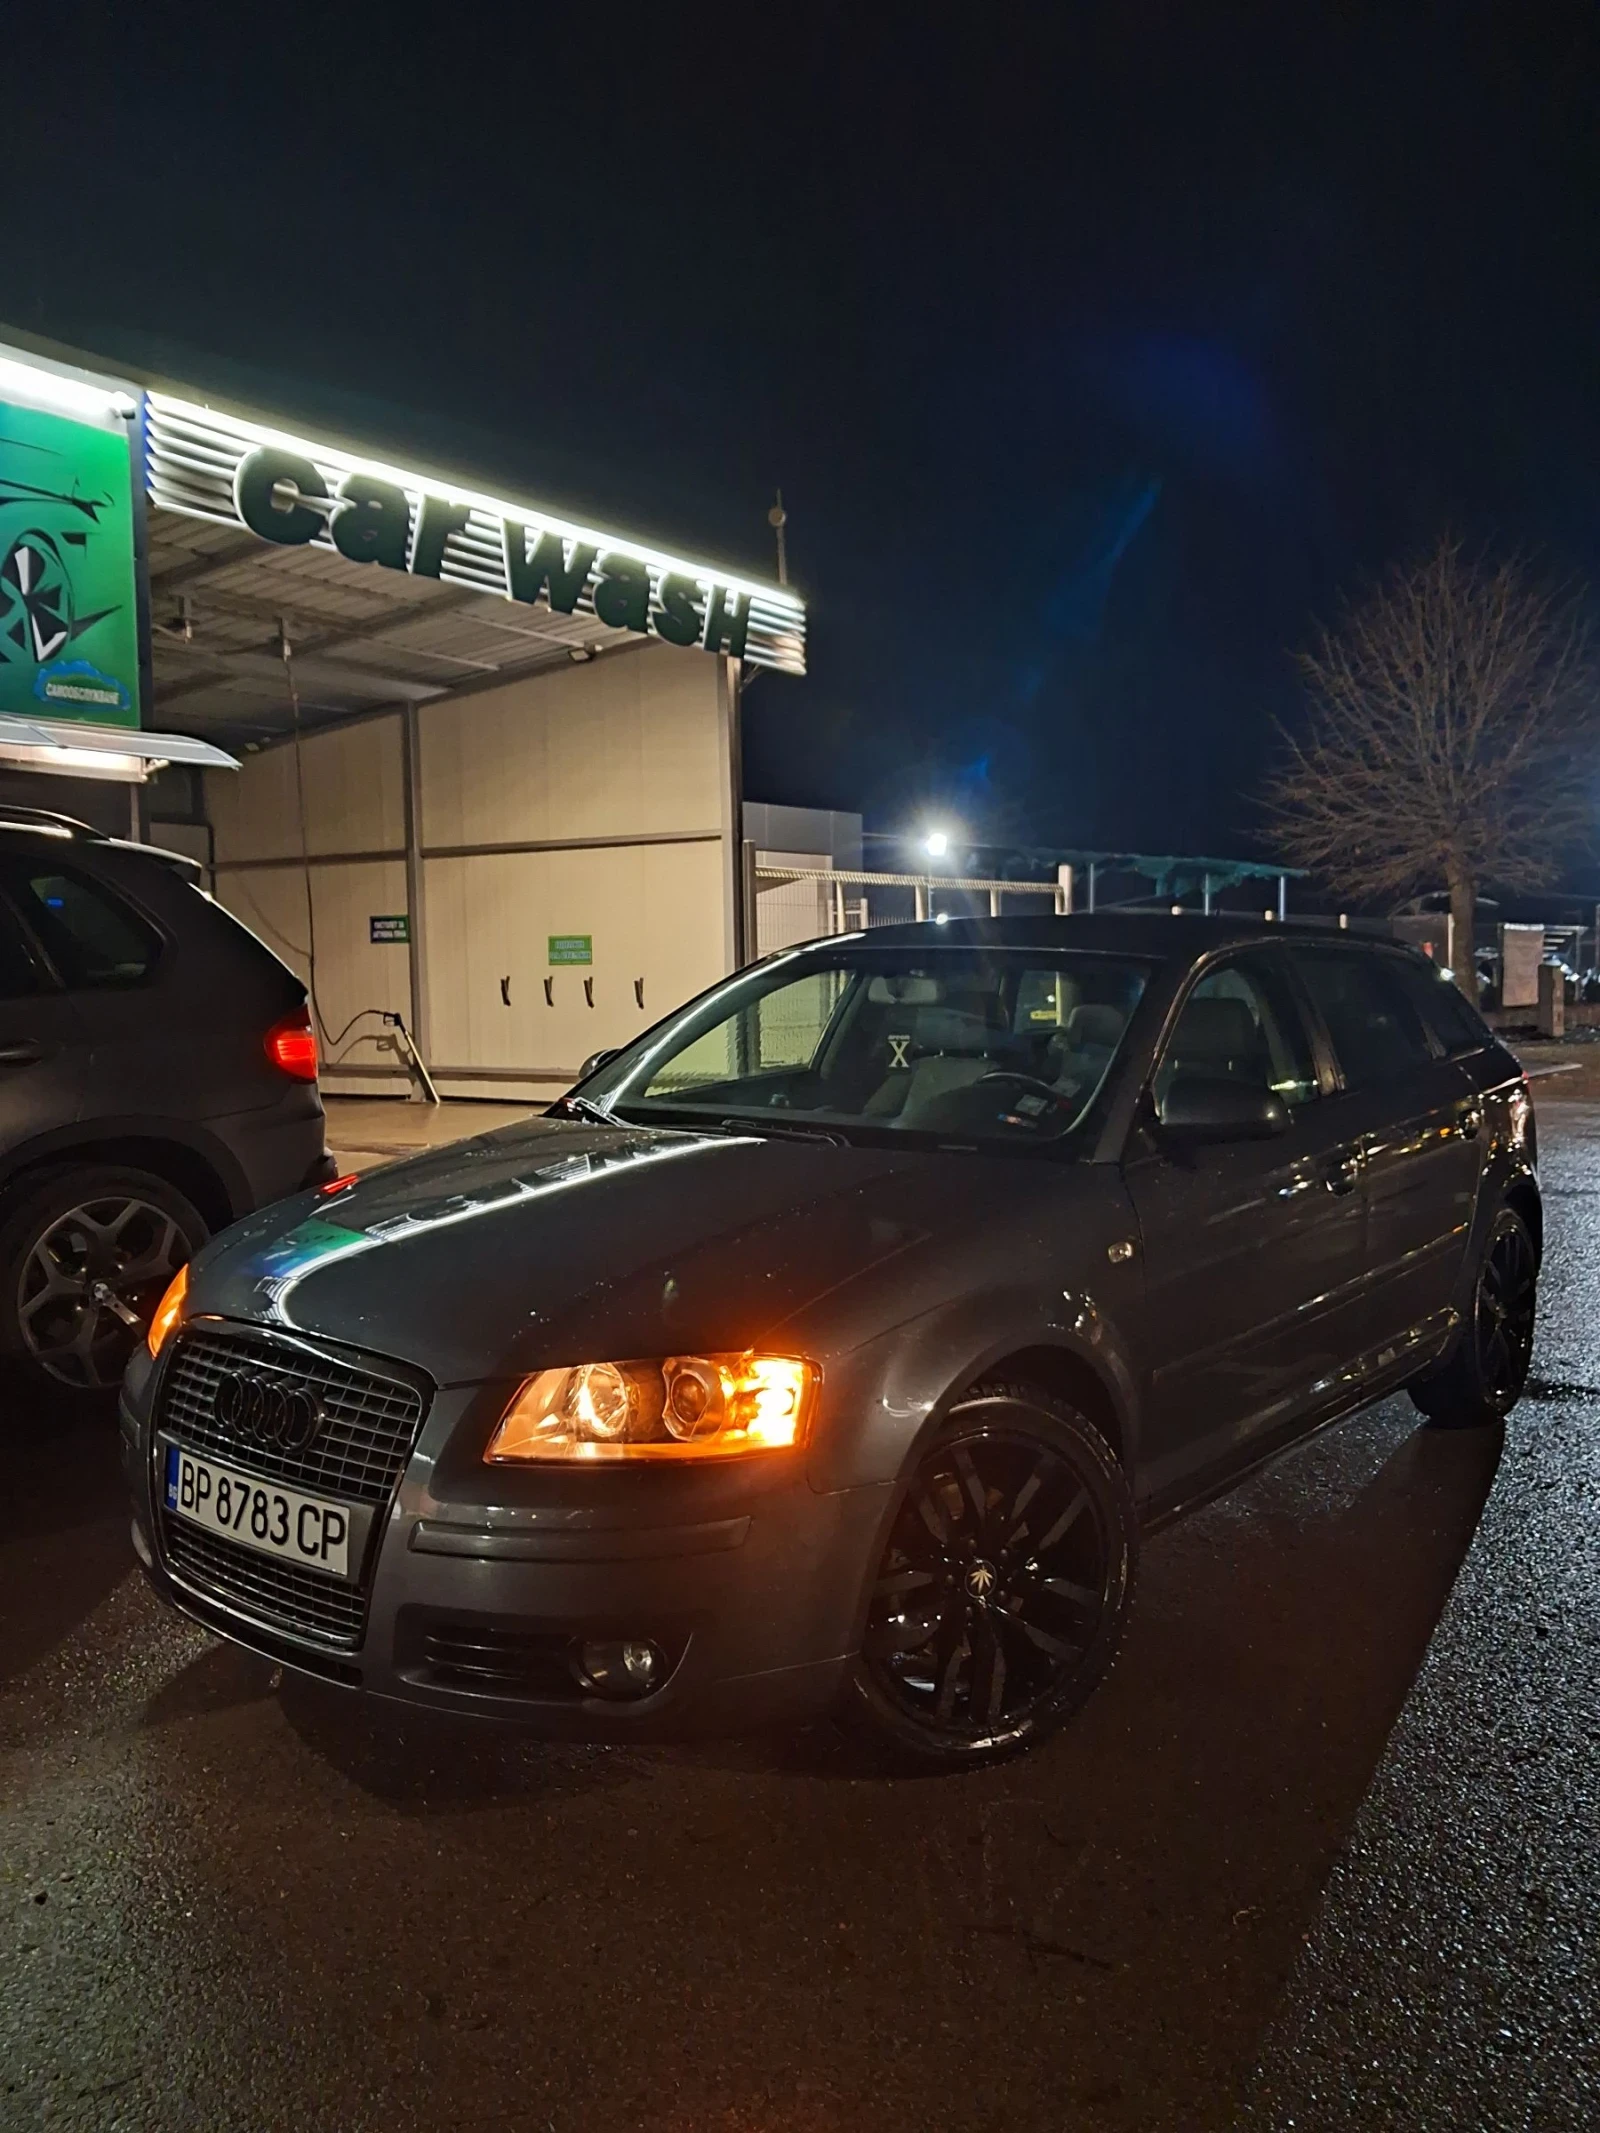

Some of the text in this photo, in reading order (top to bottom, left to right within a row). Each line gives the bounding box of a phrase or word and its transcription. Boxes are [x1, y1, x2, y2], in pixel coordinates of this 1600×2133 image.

[232, 446, 471, 580] car
[181, 1459, 346, 1560] BP 8783 CP
